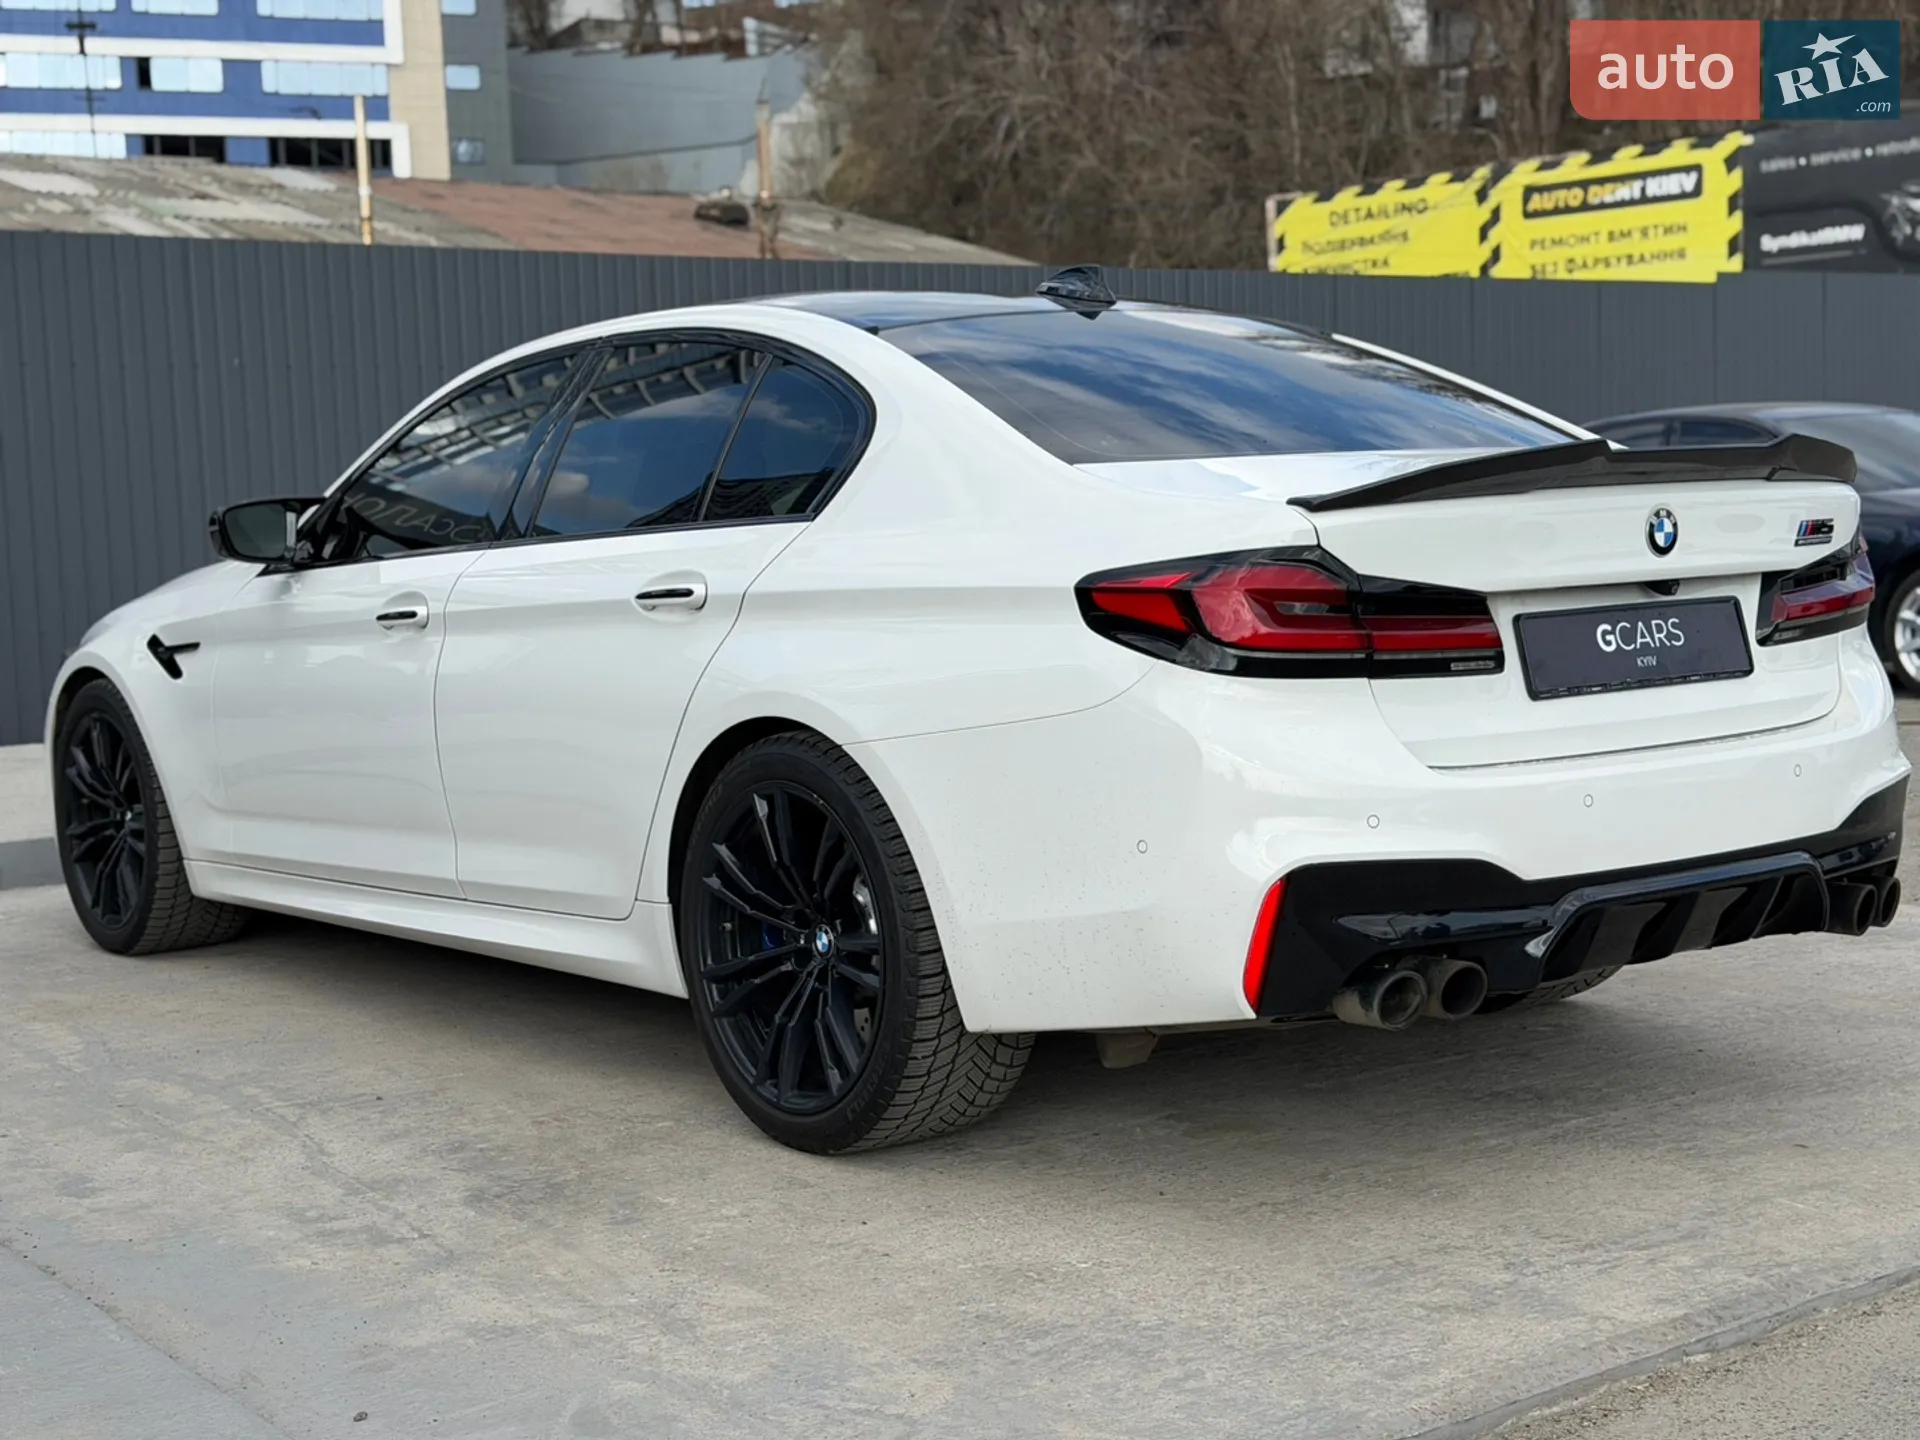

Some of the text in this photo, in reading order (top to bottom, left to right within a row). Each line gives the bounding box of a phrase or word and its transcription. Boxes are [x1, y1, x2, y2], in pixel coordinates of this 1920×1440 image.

[1526, 170, 1700, 213] AUTO DENT KIEV
[1328, 198, 1429, 227] DETAILING
[1529, 230, 1601, 252] РЕМОНТ
[1565, 247, 1687, 275] ФАРБУВАННЯ
[1596, 617, 1685, 653] GCARS
[1637, 655, 1657, 668] KYIV
